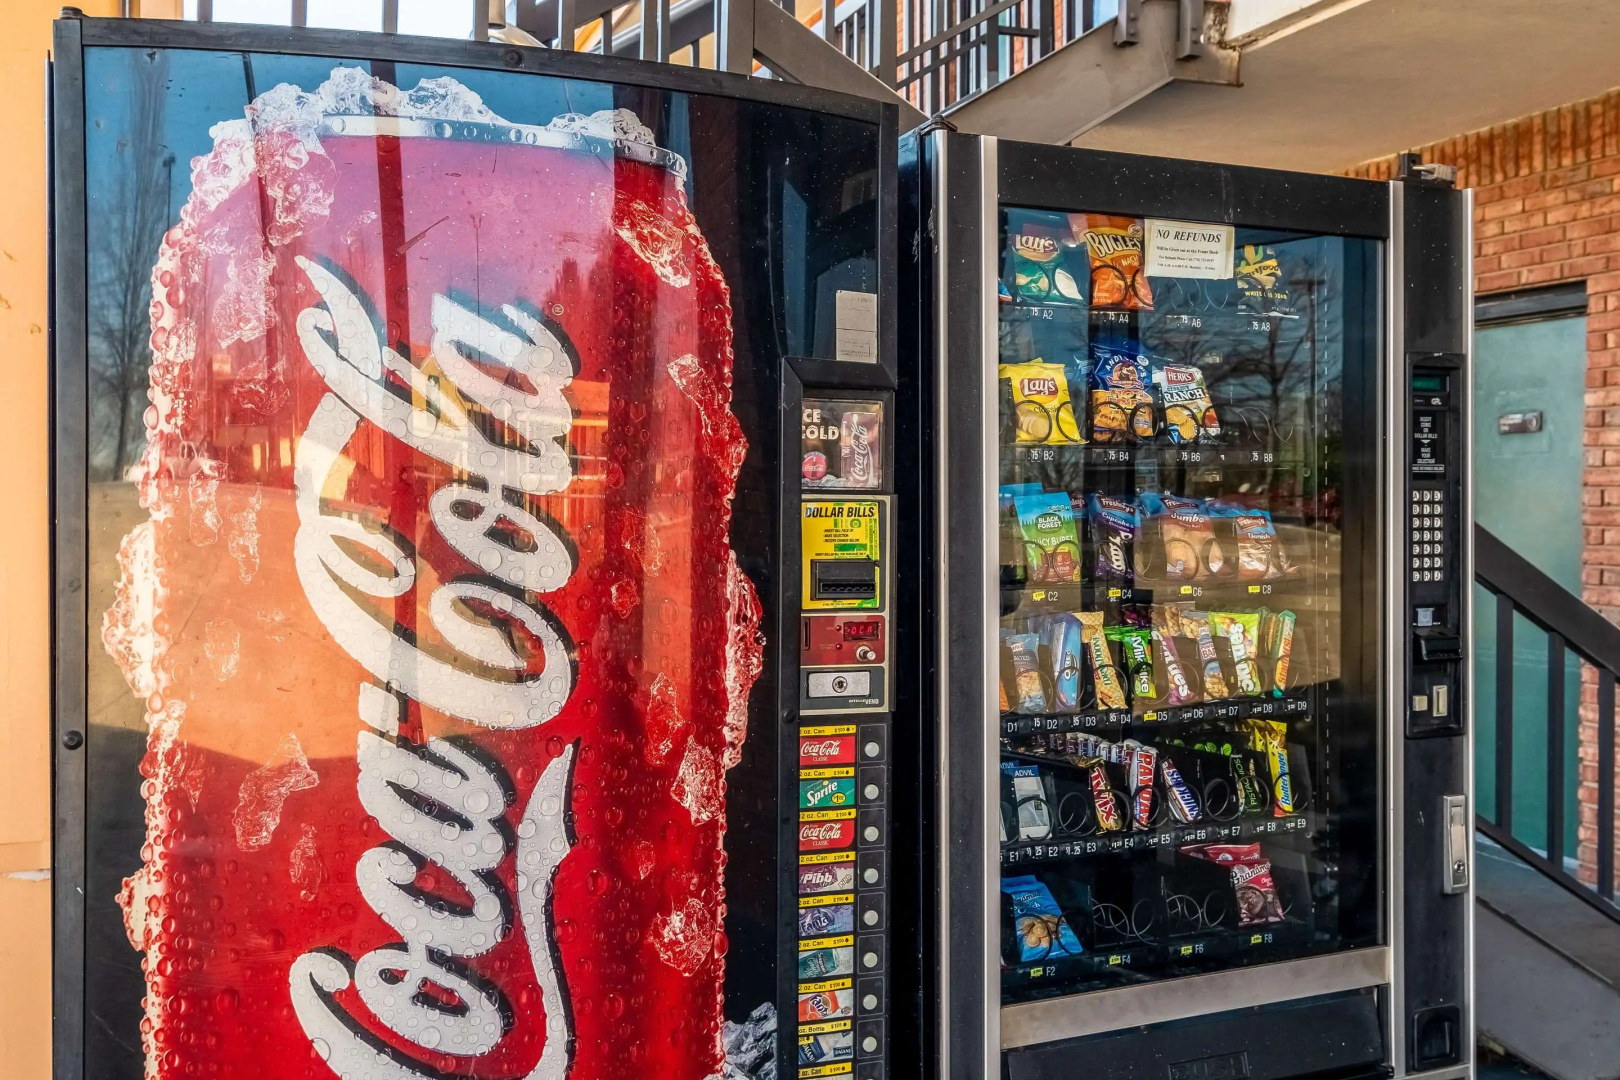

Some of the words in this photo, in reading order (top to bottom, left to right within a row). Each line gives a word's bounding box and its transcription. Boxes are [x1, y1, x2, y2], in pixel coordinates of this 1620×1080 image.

[1156, 229, 1170, 240] NO
[1173, 231, 1222, 244] REFUNDS
[1015, 234, 1055, 253] Lay's
[1085, 231, 1141, 258] BUGLES
[1121, 255, 1139, 266] NACH
[1042, 310, 1054, 320] A2
[1118, 313, 1129, 324] A4
[1192, 318, 1202, 328] A6
[1261, 322, 1270, 332] A8
[1168, 371, 1192, 382] HERR'S
[1022, 378, 1056, 396] Lay's
[1164, 388, 1205, 402] RANCH
[1034, 406, 1058, 414] Clssi
[803, 408, 822, 423] CE
[1044, 451, 1054, 460] B2
[1120, 452, 1129, 460] B4
[1191, 452, 1200, 462] B6
[1264, 453, 1273, 462] B8
[804, 506, 844, 518] DOLLAR
[846, 506, 874, 518] BILLS
[1038, 516, 1059, 524] BLACK
[1102, 512, 1134, 528] Cupcakes
[1170, 512, 1205, 523] Jumbo
[1038, 522, 1062, 530] FOREST
[1192, 587, 1202, 596] C6
[1262, 585, 1272, 594] C8
[1048, 592, 1058, 602] C2
[1122, 590, 1132, 600] C4
[289, 252, 578, 1080] Coca-Cola
[1228, 706, 1238, 716] D7
[1263, 704, 1273, 713] D8
[1297, 701, 1307, 711] D9
[1158, 712, 1168, 721] D5
[1194, 708, 1204, 718] D6
[1086, 716, 1096, 726] D3
[1120, 714, 1131, 724] D4
[1008, 722, 1018, 732] D1
[1046, 720, 1058, 730] D2
[801, 740, 841, 756] Coca-Cola
[1234, 758, 1258, 806] PISTACIOS
[1278, 751, 1291, 806] Butteringer
[806, 782, 838, 806] Sprite
[1091, 767, 1118, 824] TWIX
[1268, 822, 1276, 832] E8
[1298, 818, 1306, 828] E9
[800, 823, 842, 841] Coca-Cola
[1197, 830, 1206, 840] E6
[1232, 826, 1240, 836] E7
[1124, 838, 1134, 848] E4
[1162, 834, 1170, 844] E5
[1048, 847, 1058, 857] E2
[1086, 843, 1096, 852] E3
[1010, 852, 1019, 861] E1
[802, 872, 833, 884] Pibb
[1264, 934, 1272, 942] F8
[1194, 944, 1204, 954] F6
[1122, 956, 1130, 964] F4
[1046, 966, 1056, 976] F2
